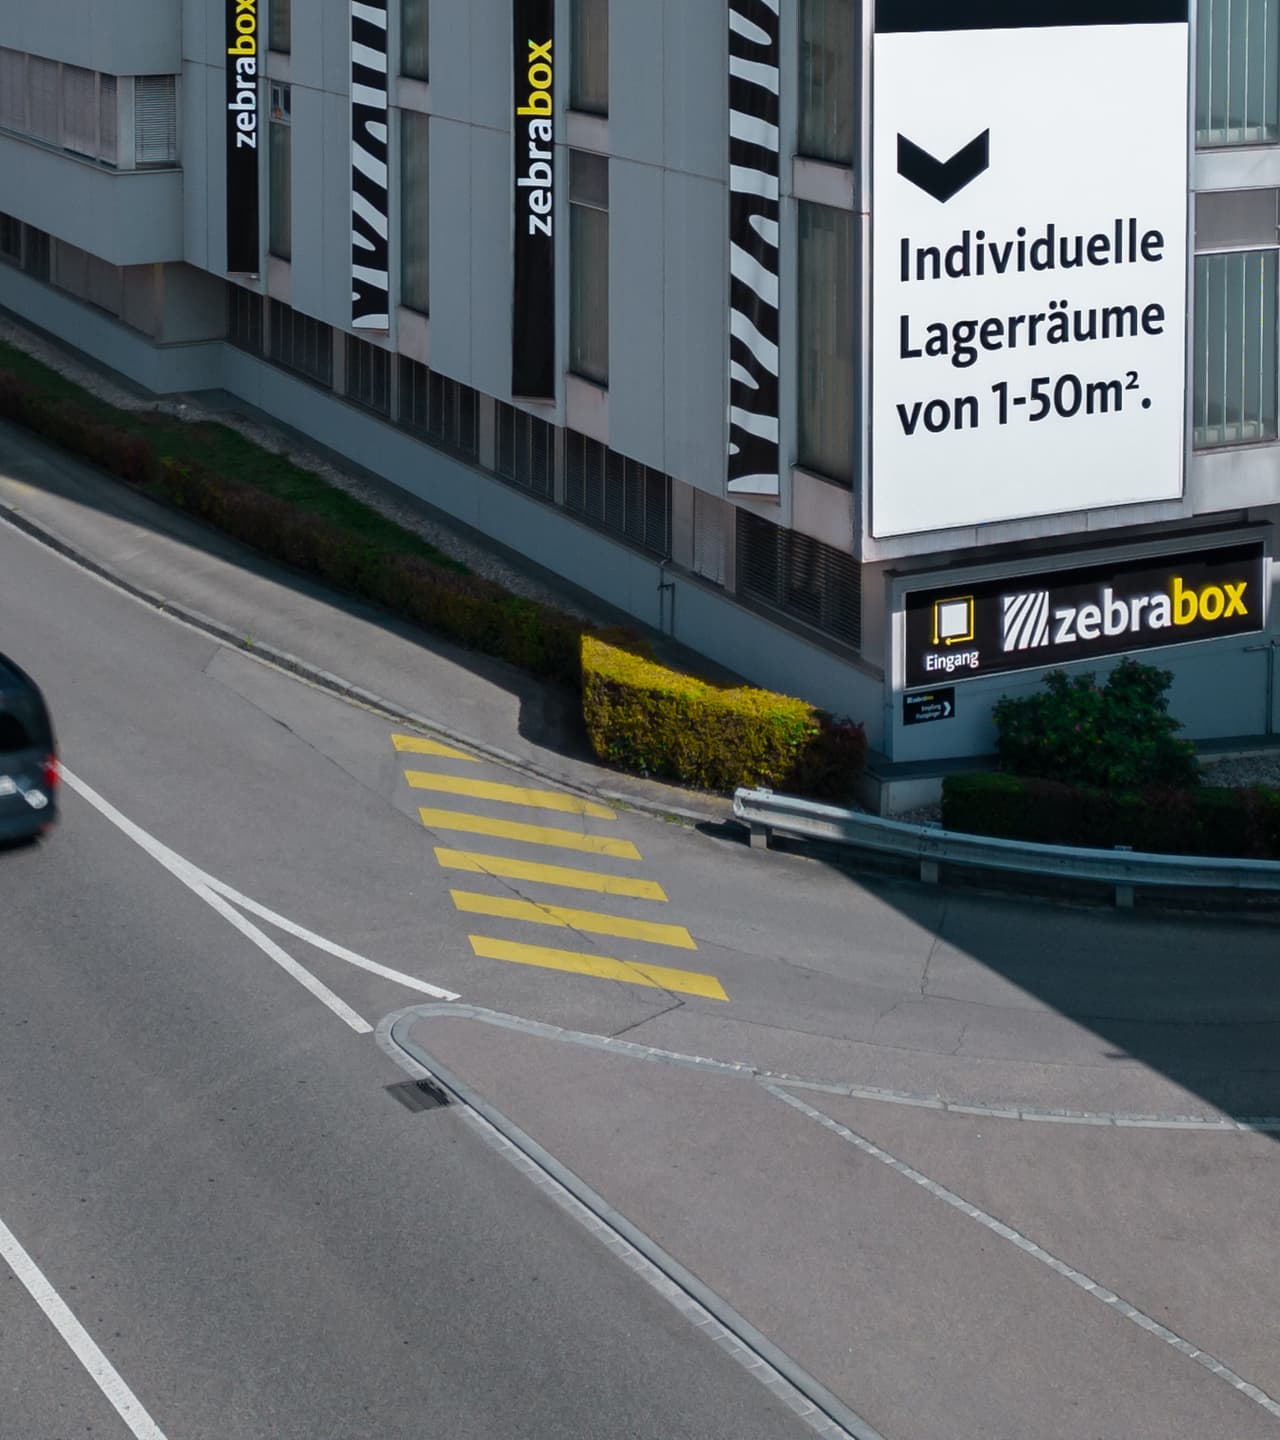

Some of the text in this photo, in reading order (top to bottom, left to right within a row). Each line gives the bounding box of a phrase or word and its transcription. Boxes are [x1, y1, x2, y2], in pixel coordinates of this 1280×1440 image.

[516, 40, 553, 237] zebrabox
[900, 217, 1164, 282] Individuelle
[900, 299, 1165, 368] Lagerräume
[896, 370, 1153, 436] von 1-50m².
[1053, 575, 1249, 645] zebrabox
[925, 651, 980, 672] Eingang
